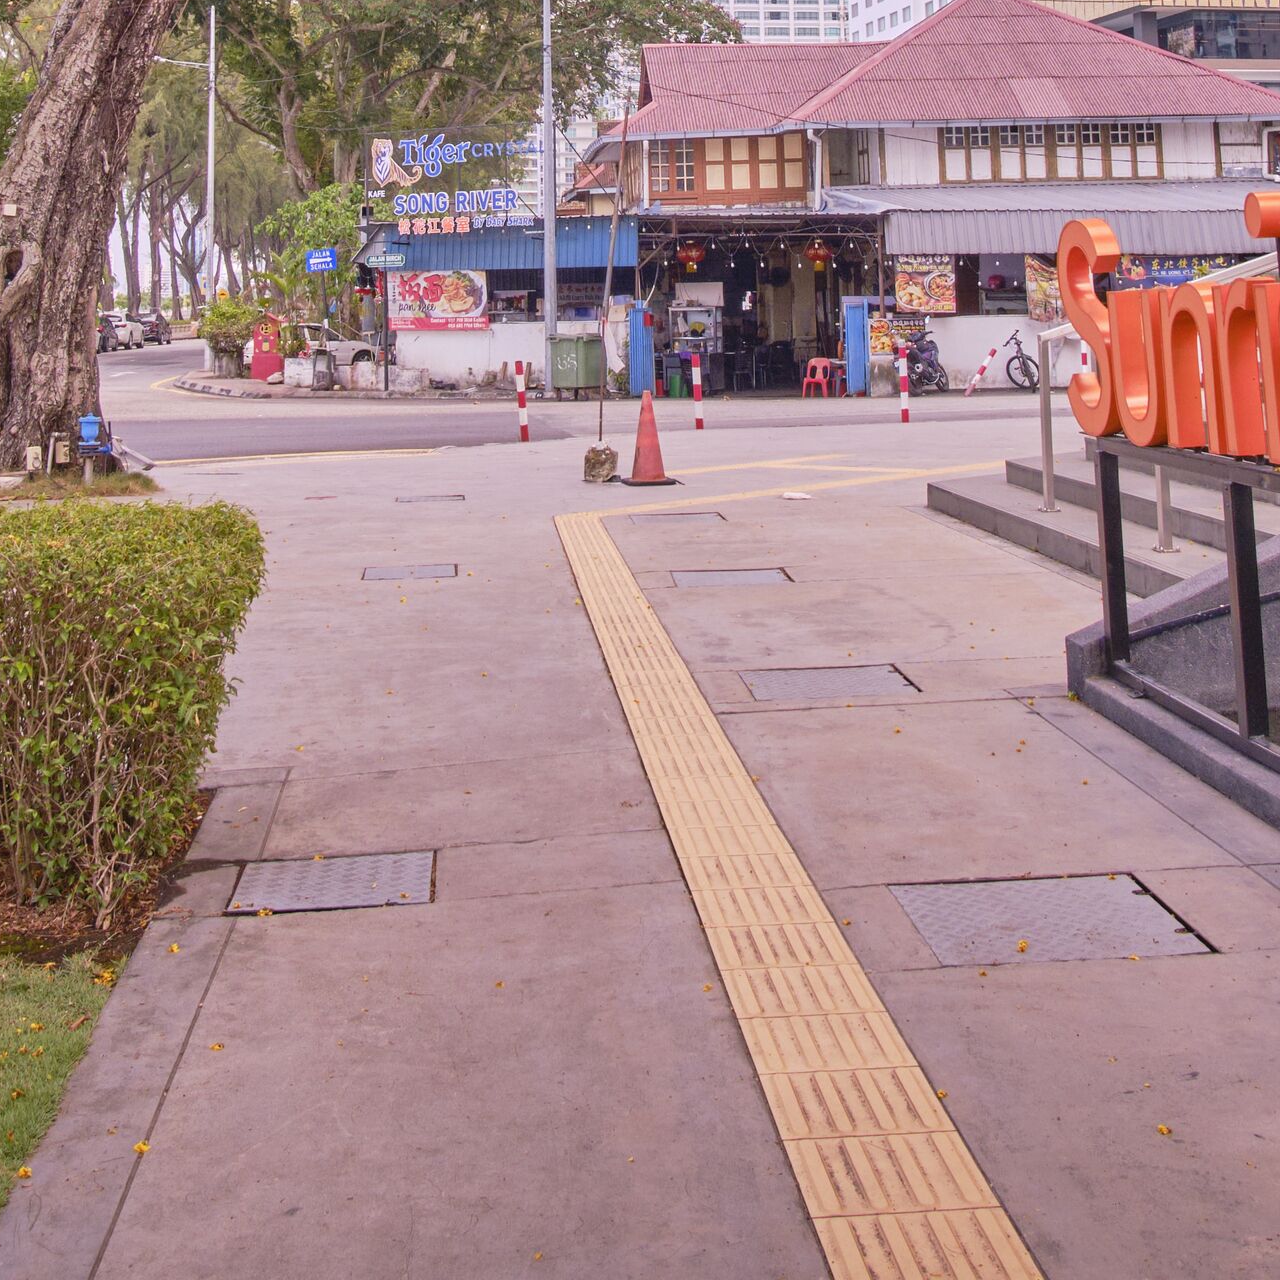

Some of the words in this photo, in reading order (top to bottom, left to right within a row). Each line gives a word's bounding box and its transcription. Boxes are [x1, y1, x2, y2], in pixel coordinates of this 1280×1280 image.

[398, 134, 471, 177] Tiger
[368, 190, 386, 198] KAFE
[394, 192, 449, 215] SONG
[455, 189, 519, 212] RIVER
